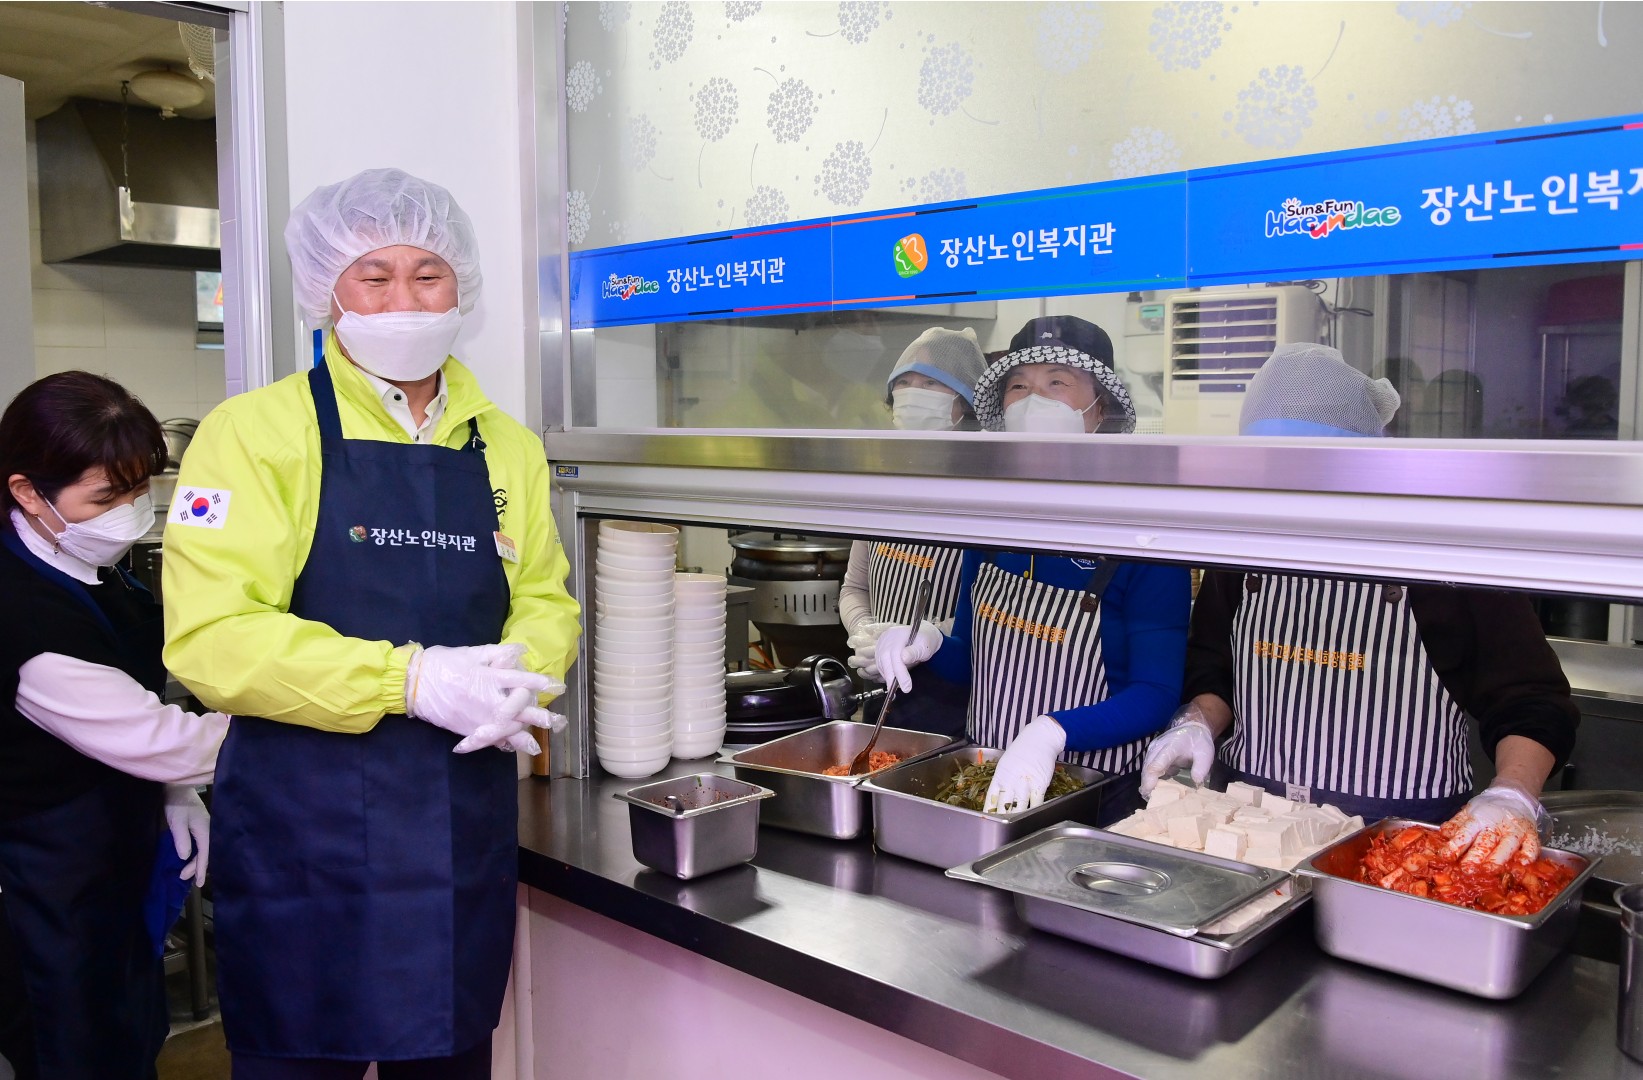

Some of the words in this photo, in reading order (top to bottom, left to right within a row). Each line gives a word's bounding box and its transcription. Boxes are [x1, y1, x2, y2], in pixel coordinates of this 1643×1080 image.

[1265, 201, 1401, 239] Haeundae
[1287, 201, 1353, 216] Sun&Fun
[939, 222, 1117, 268] 장산노인복지관
[666, 257, 786, 293] 장산노인복지관
[370, 527, 477, 552] 장산노인복지관
